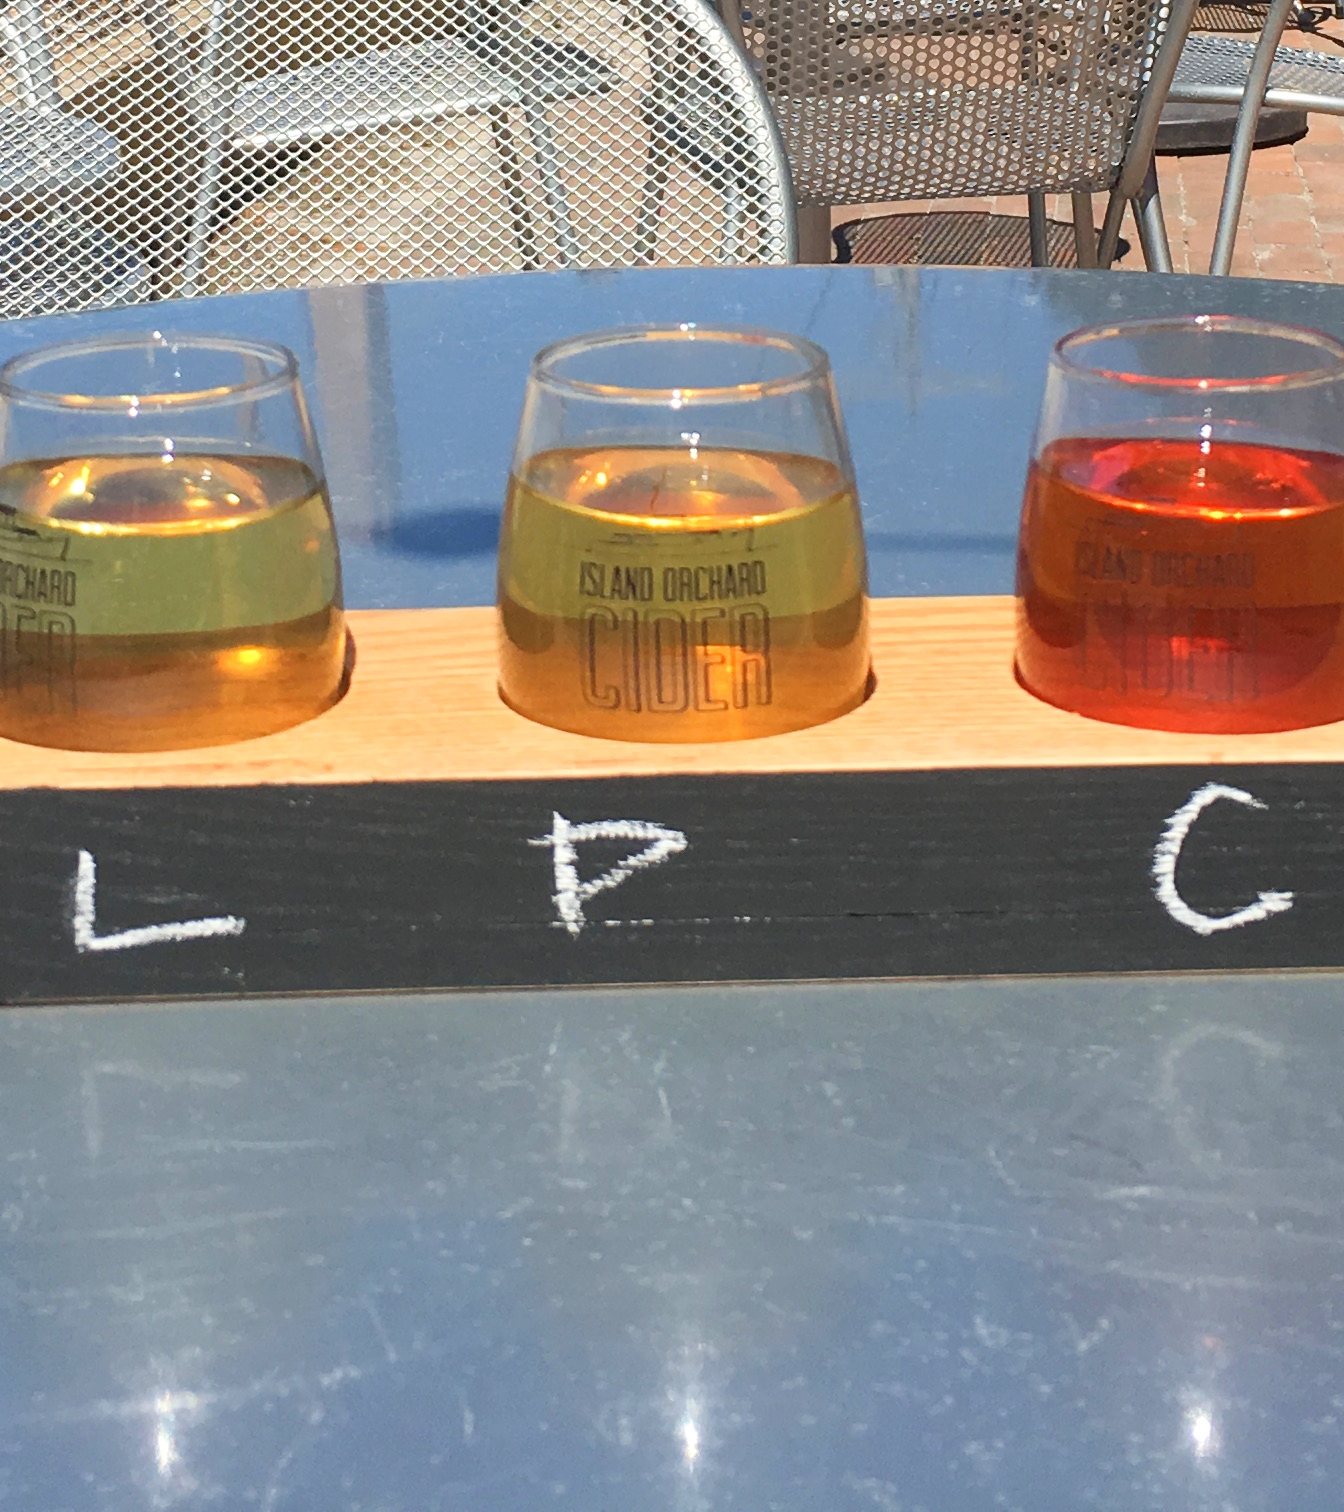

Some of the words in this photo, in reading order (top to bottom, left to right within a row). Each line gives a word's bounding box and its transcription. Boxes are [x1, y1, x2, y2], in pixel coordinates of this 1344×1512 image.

[579, 560, 654, 602] ISLAND
[662, 560, 767, 602] ORCHARD
[580, 602, 773, 713] CIDER
[73, 848, 247, 953] L
[528, 810, 688, 936] P
[1152, 781, 1295, 936] C
